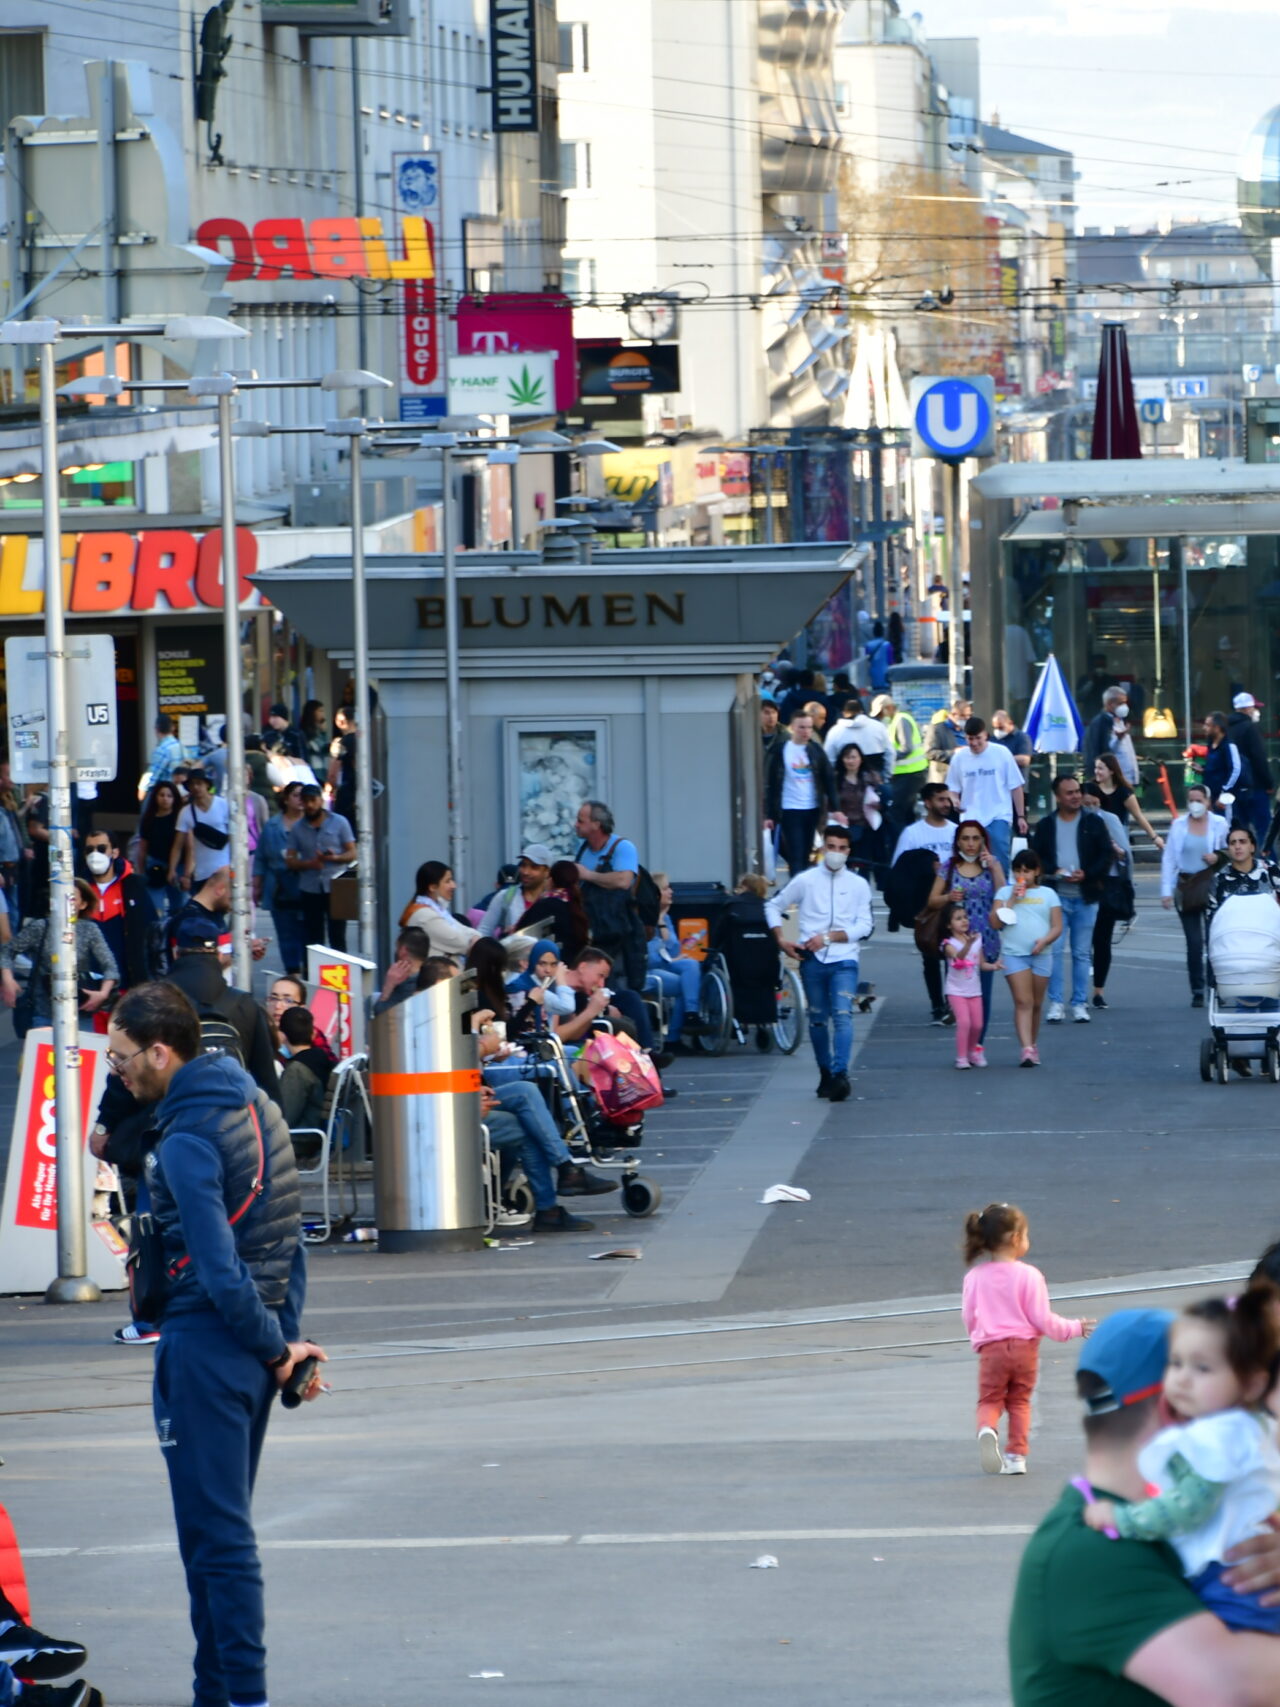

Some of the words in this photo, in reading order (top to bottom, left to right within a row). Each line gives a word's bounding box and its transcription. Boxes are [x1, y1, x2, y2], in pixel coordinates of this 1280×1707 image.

[926, 393, 978, 448] U
[1143, 403, 1161, 421] U
[415, 593, 686, 629] BLUMEN
[88, 705, 108, 723] U5
